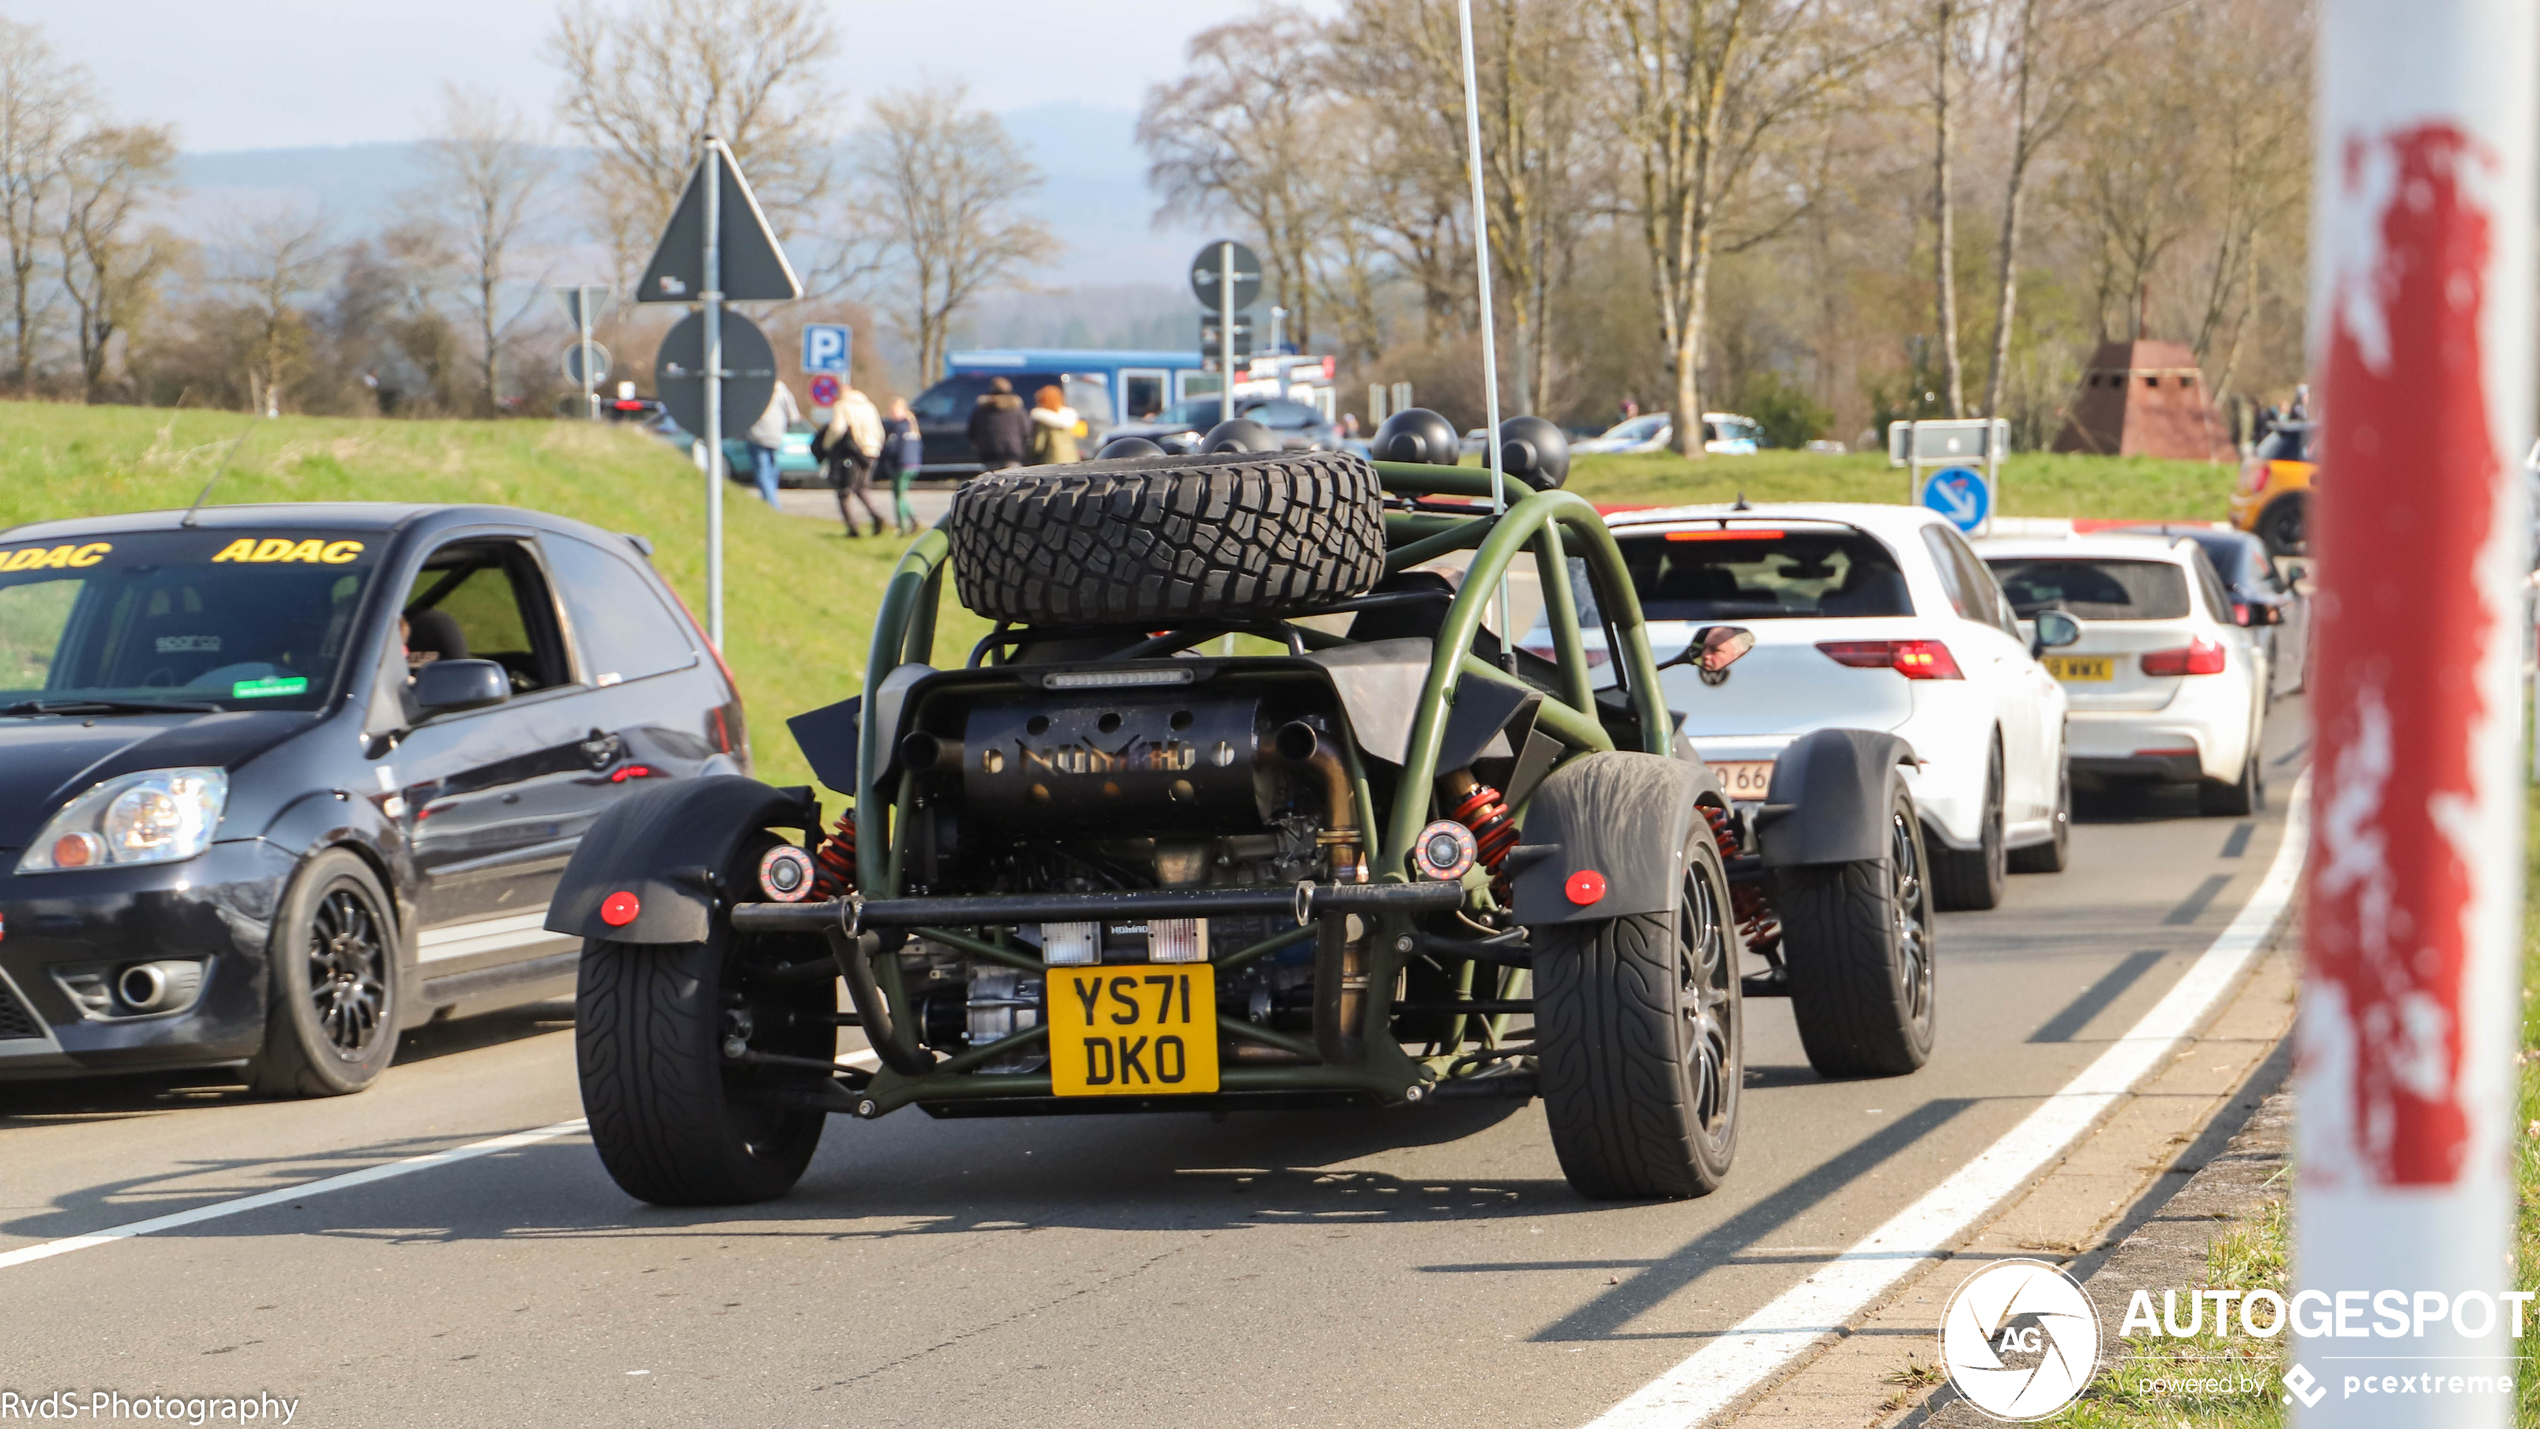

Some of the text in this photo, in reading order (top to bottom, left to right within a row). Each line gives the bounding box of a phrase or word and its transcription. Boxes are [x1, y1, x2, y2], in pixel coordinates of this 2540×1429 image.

[809, 329, 843, 367] P
[211, 538, 365, 564] ADAC
[1110, 925, 1149, 935] NOMAD
[1073, 974, 1191, 1026] YS71
[1083, 1034, 1186, 1086] DKO
